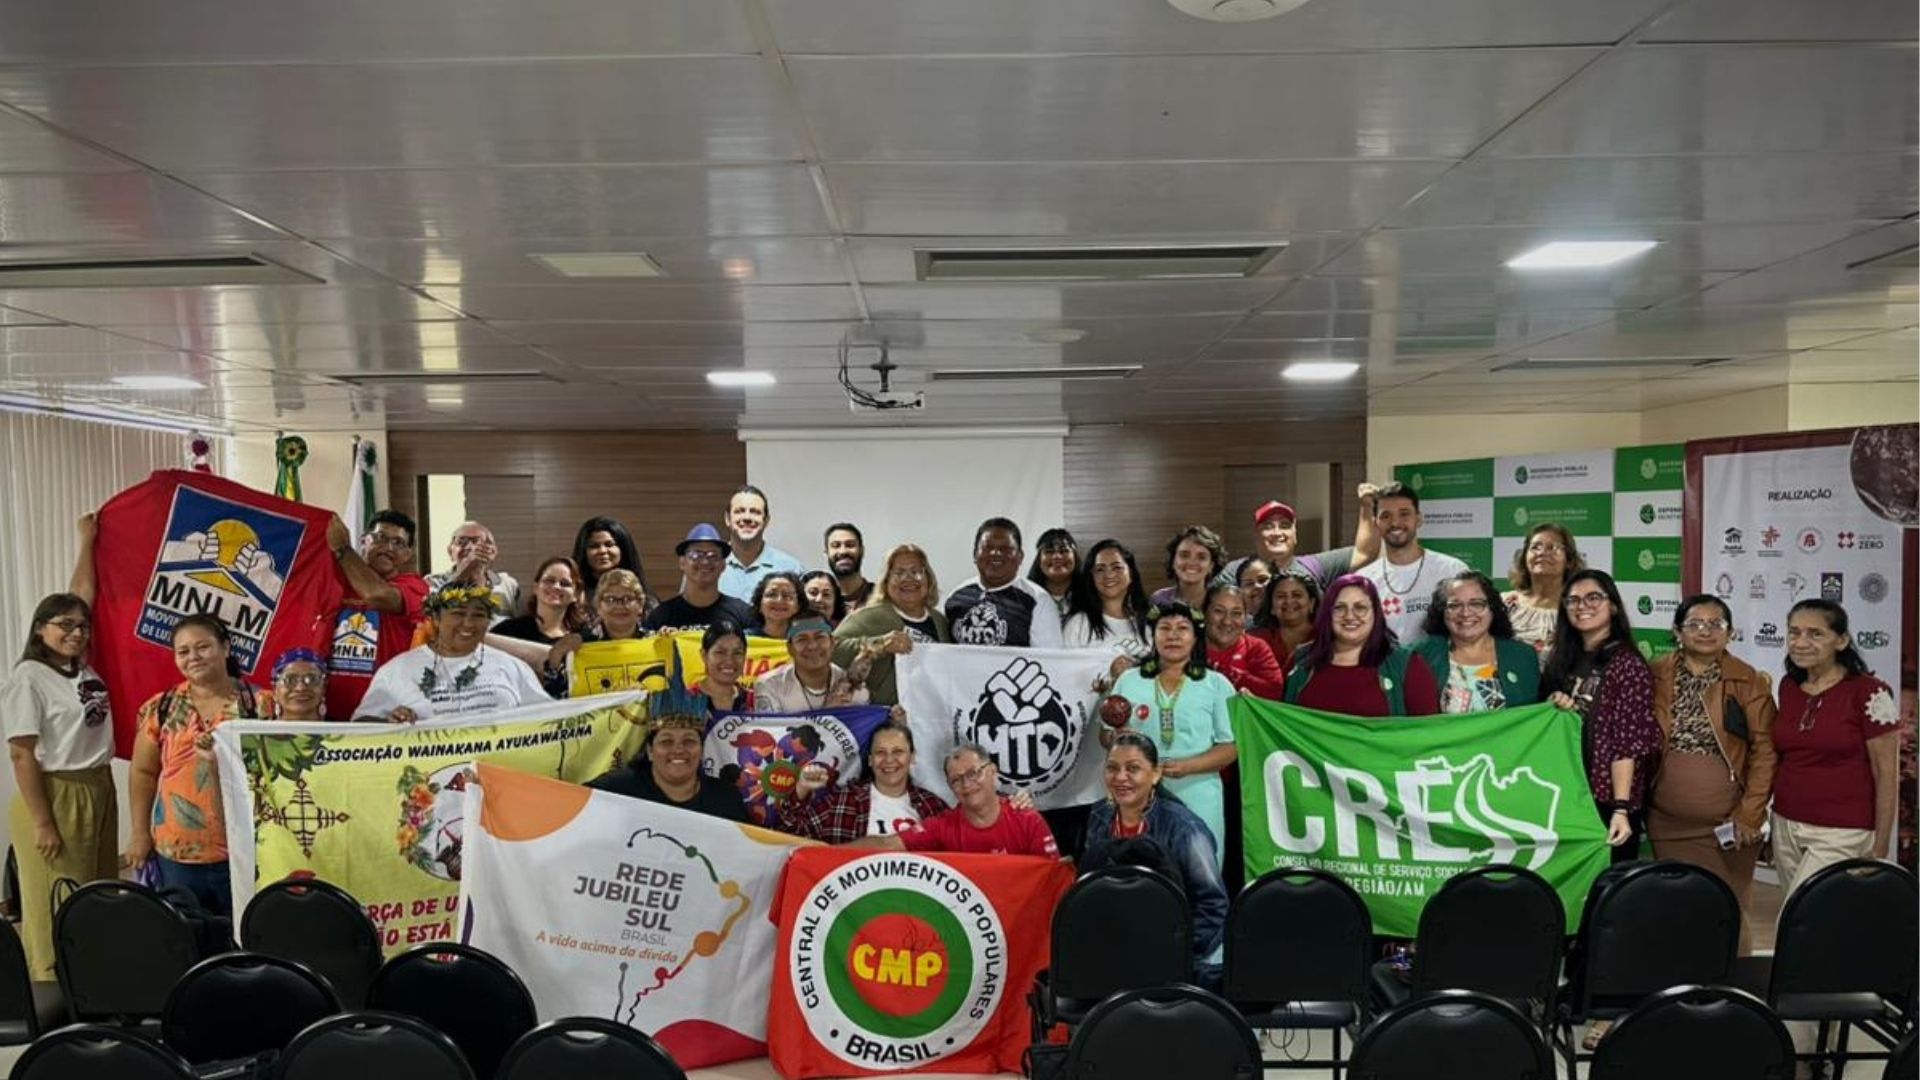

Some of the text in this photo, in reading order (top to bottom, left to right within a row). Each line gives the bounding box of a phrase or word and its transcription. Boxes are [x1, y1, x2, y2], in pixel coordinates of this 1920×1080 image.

[1768, 487, 1832, 501] REALIZAÇÃO
[1858, 540, 1884, 550] ZERO
[150, 574, 270, 637] MNLM
[316, 725, 592, 763] ASSOCIAÇÃO WAINAKANA AYUKAWARANA
[977, 721, 1065, 776] MTD
[769, 774, 795, 787] CMP
[616, 862, 686, 892] REDE
[1273, 855, 1322, 870] CONSELHO
[1323, 860, 1371, 875] REGIONAL
[1373, 864, 1385, 876] DE
[1389, 865, 1432, 879] SERVIÇO
[573, 876, 681, 911] JUBILEU
[366, 895, 459, 925] RÇA DE U
[624, 908, 673, 932] SUL
[406, 918, 451, 944] ESTÁ
[536, 930, 546, 943] A
[549, 934, 577, 949] vida
[580, 939, 616, 955] acima
[620, 944, 637, 958] da
[620, 930, 668, 947] BRASIL
[798, 860, 1000, 1020] CENTRAL DE MOVIMENTOS POPULARES
[852, 943, 943, 987] CMP
[844, 1034, 941, 1064] BRASIL
